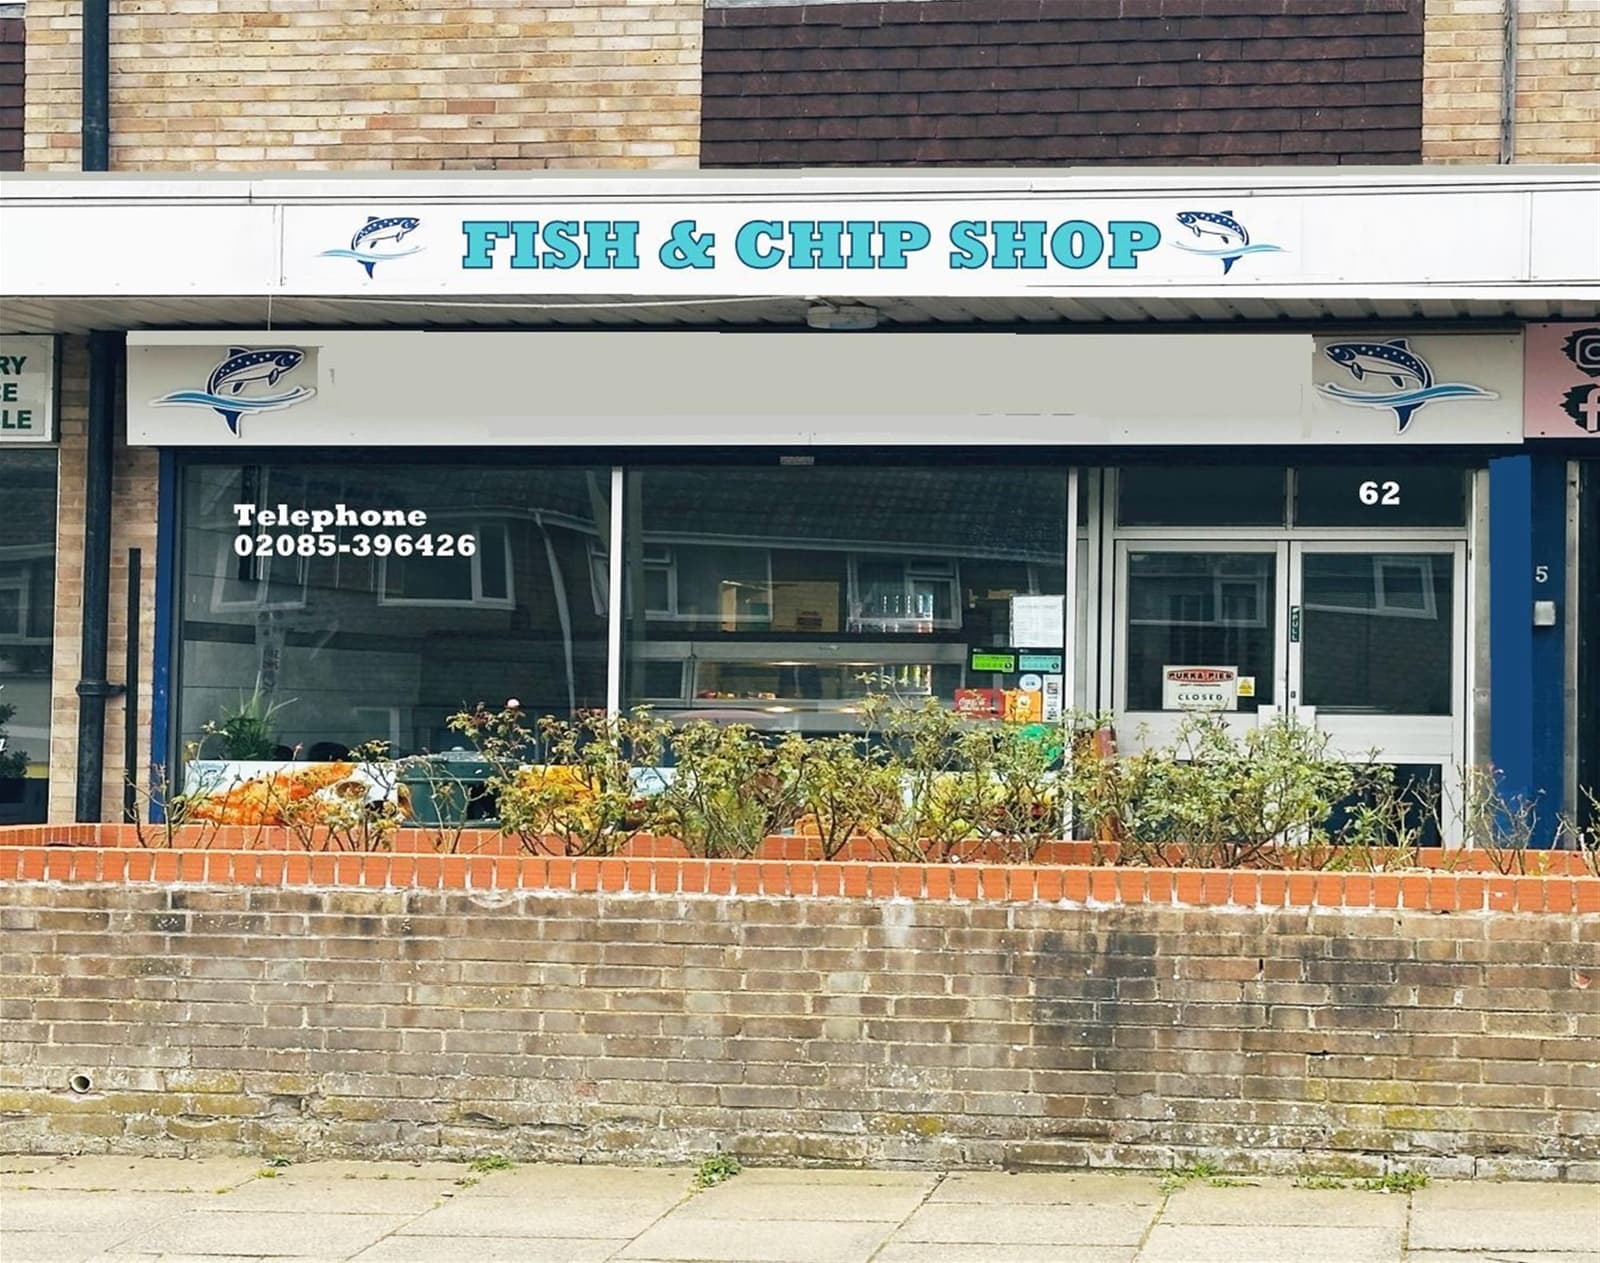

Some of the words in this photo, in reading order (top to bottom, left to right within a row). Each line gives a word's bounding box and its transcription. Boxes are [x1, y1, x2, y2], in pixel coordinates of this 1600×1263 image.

[462, 220, 640, 270] FISH
[658, 219, 715, 270] &
[735, 219, 931, 270] CHIP
[949, 219, 1162, 270] SHOP
[1359, 481, 1400, 506] 62
[233, 504, 428, 533] Telephone
[234, 534, 477, 557] 02085-396426
[1535, 566, 1549, 583] 5
[1177, 693, 1224, 701] CLOSED
